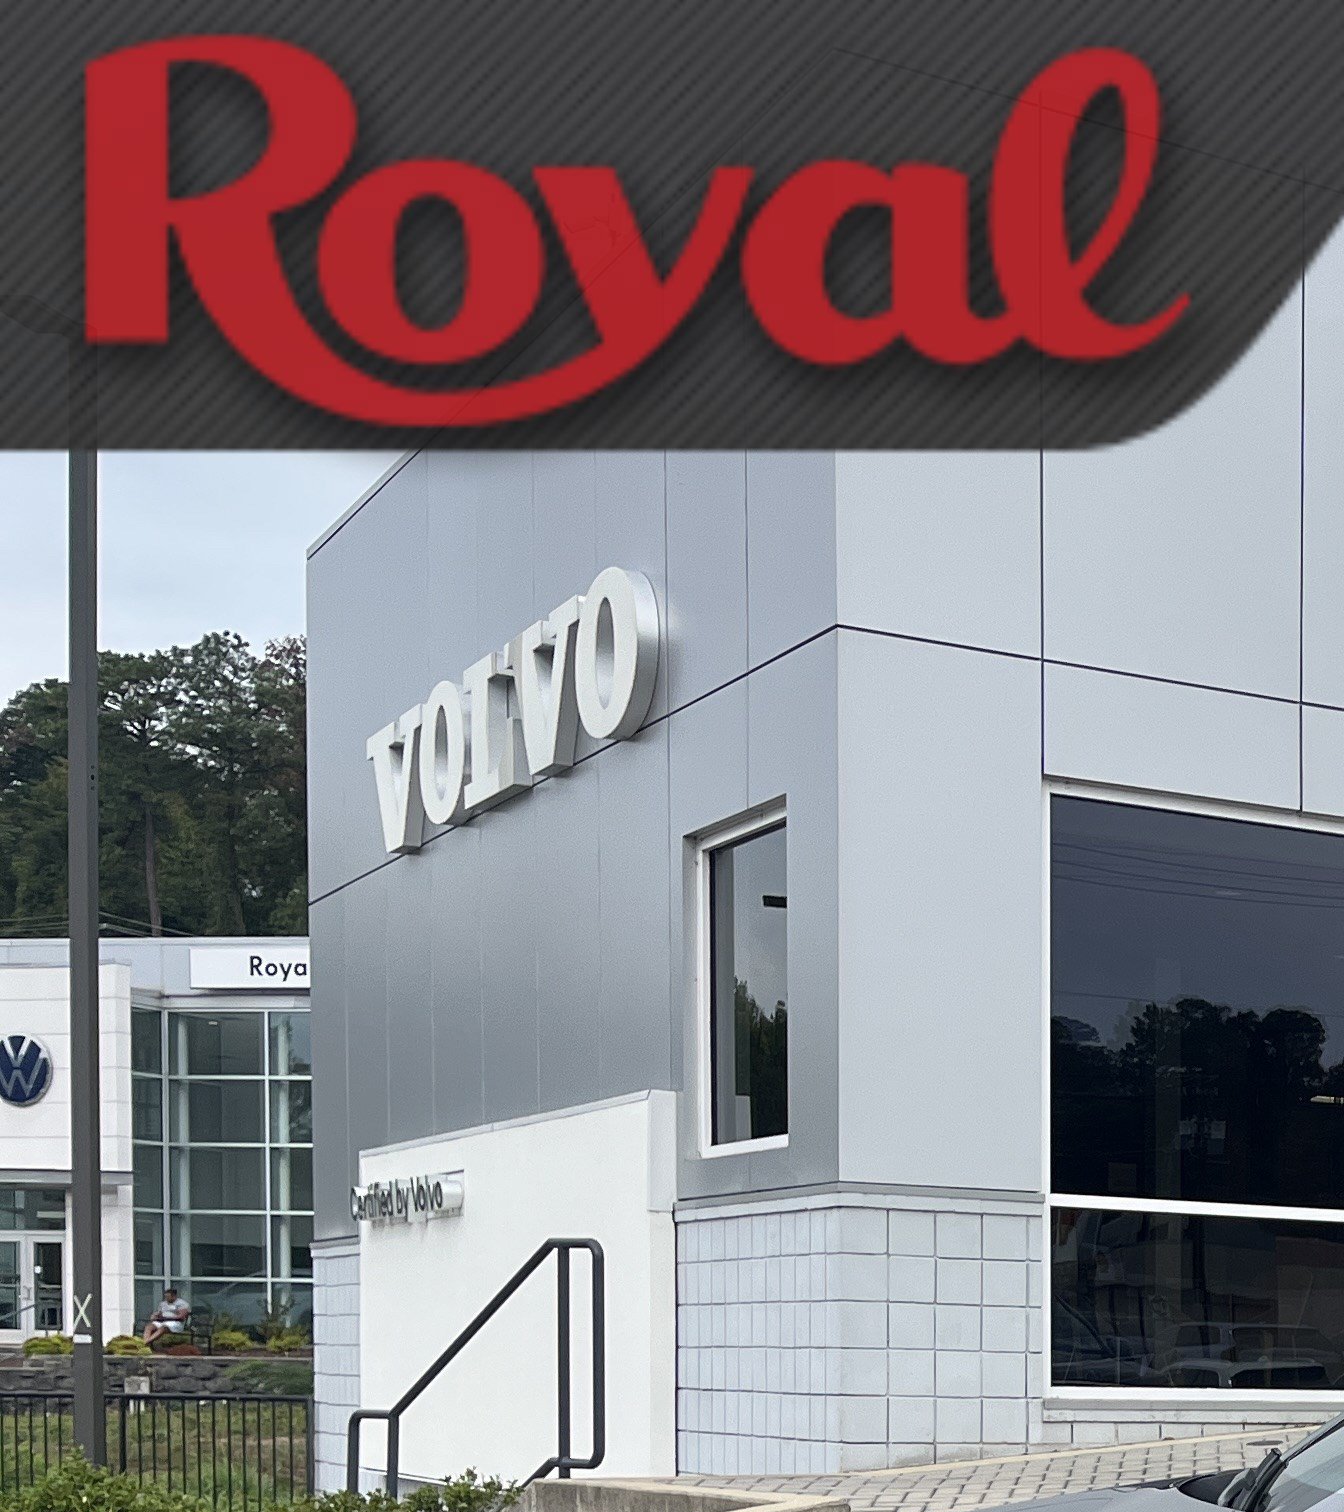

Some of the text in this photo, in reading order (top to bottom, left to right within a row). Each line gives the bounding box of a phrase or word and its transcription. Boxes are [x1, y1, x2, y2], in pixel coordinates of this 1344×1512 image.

[367, 566, 658, 853] VOLVO
[249, 955, 307, 982] Roya
[394, 1178, 410, 1222] by
[410, 1174, 443, 1212] Volvo
